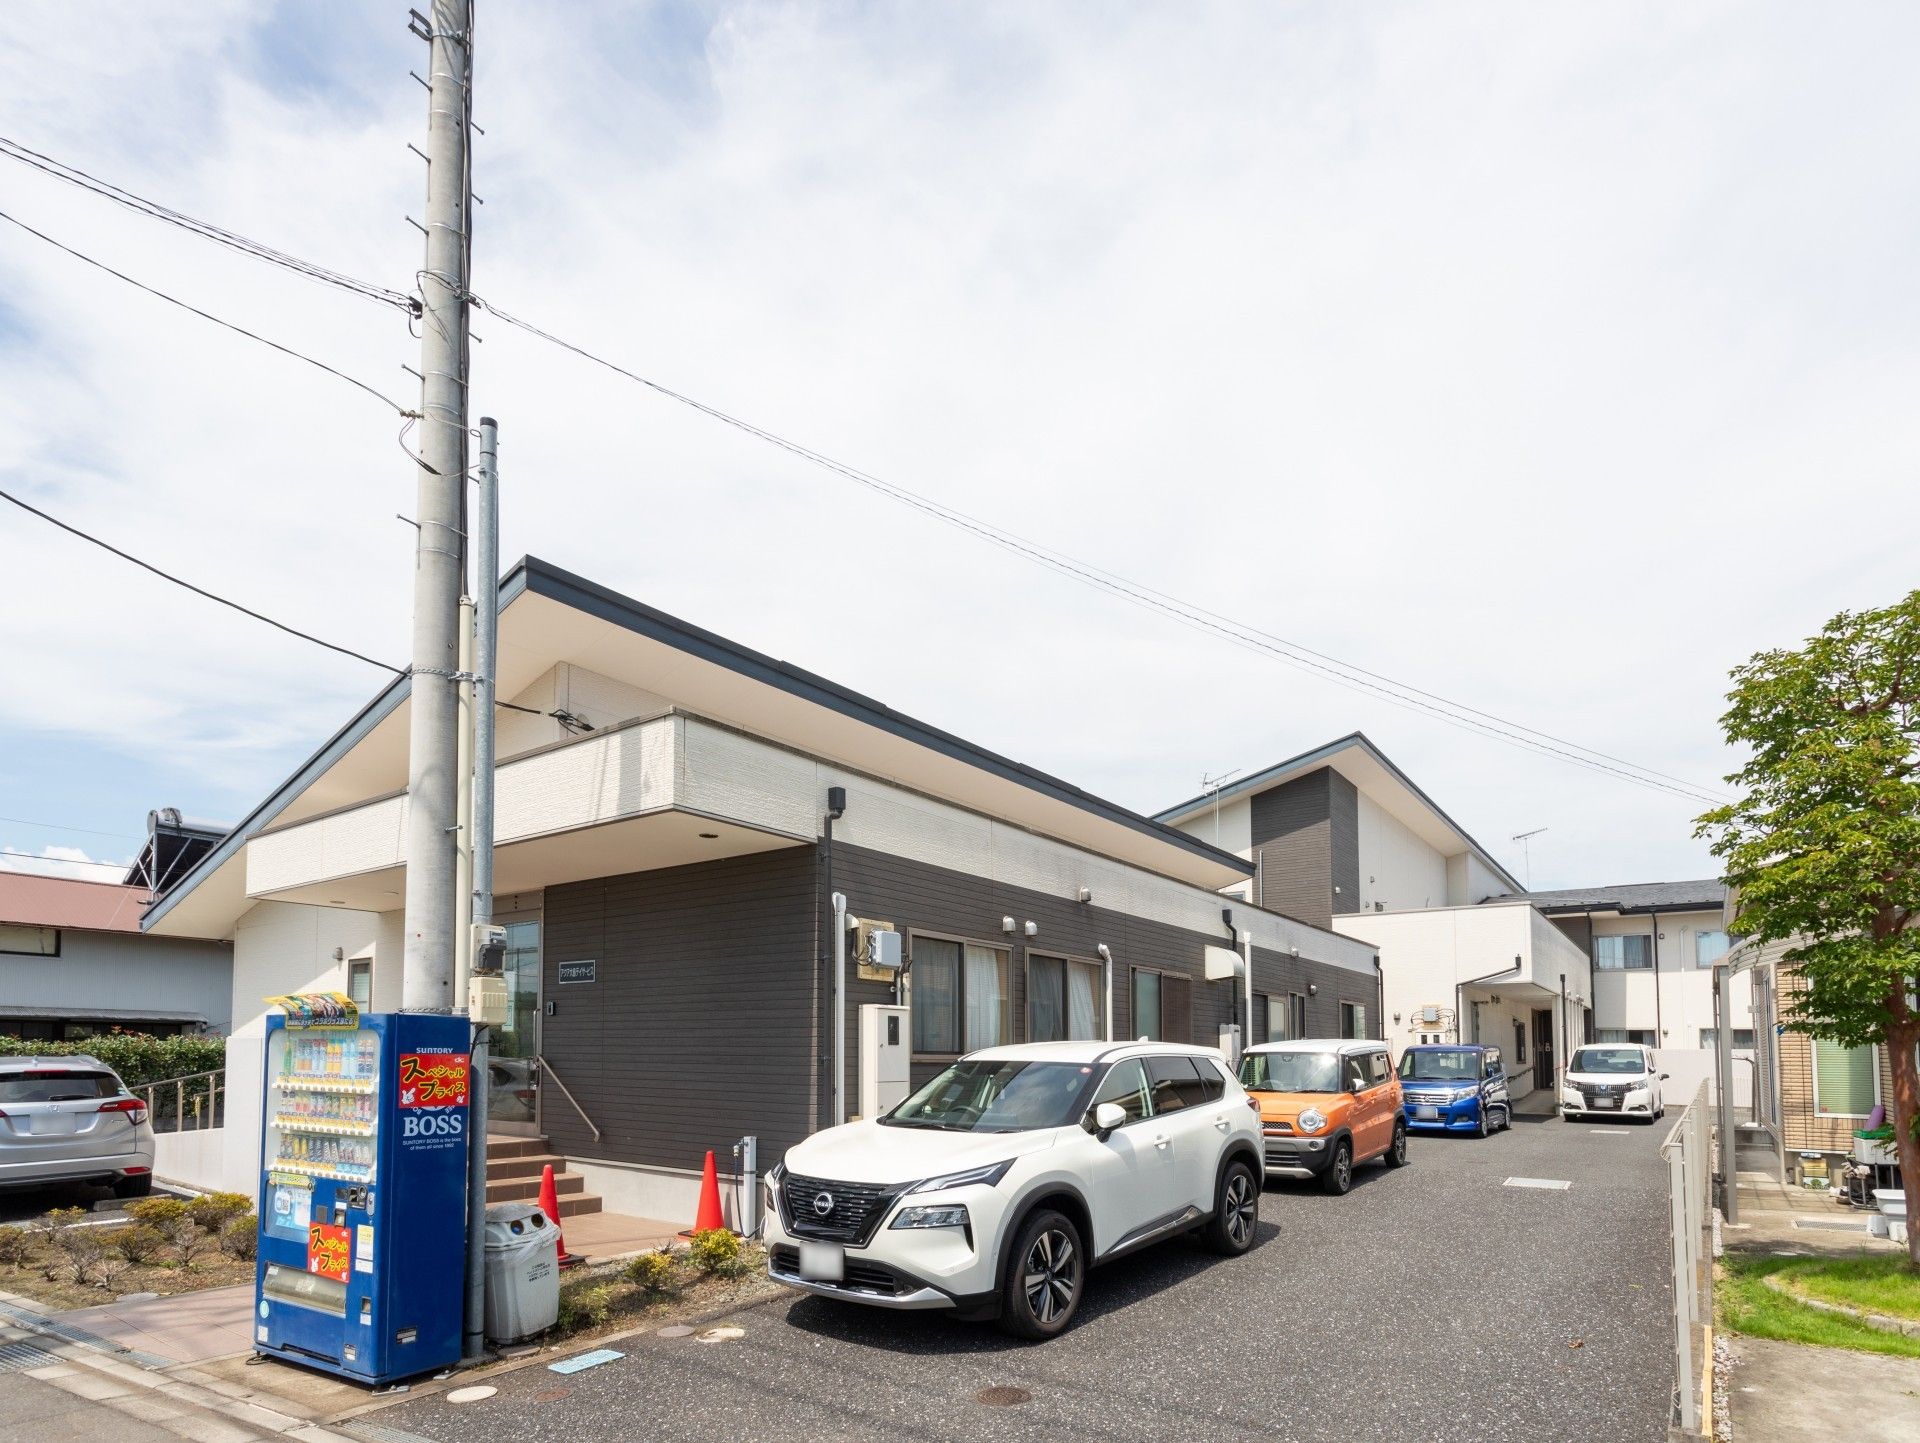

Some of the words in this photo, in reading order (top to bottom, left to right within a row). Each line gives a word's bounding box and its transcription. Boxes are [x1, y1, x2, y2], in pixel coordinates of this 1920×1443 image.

[401, 1057, 464, 1083] スペシャル
[419, 1079, 465, 1101] プライス
[403, 1114, 462, 1137] BOSS
